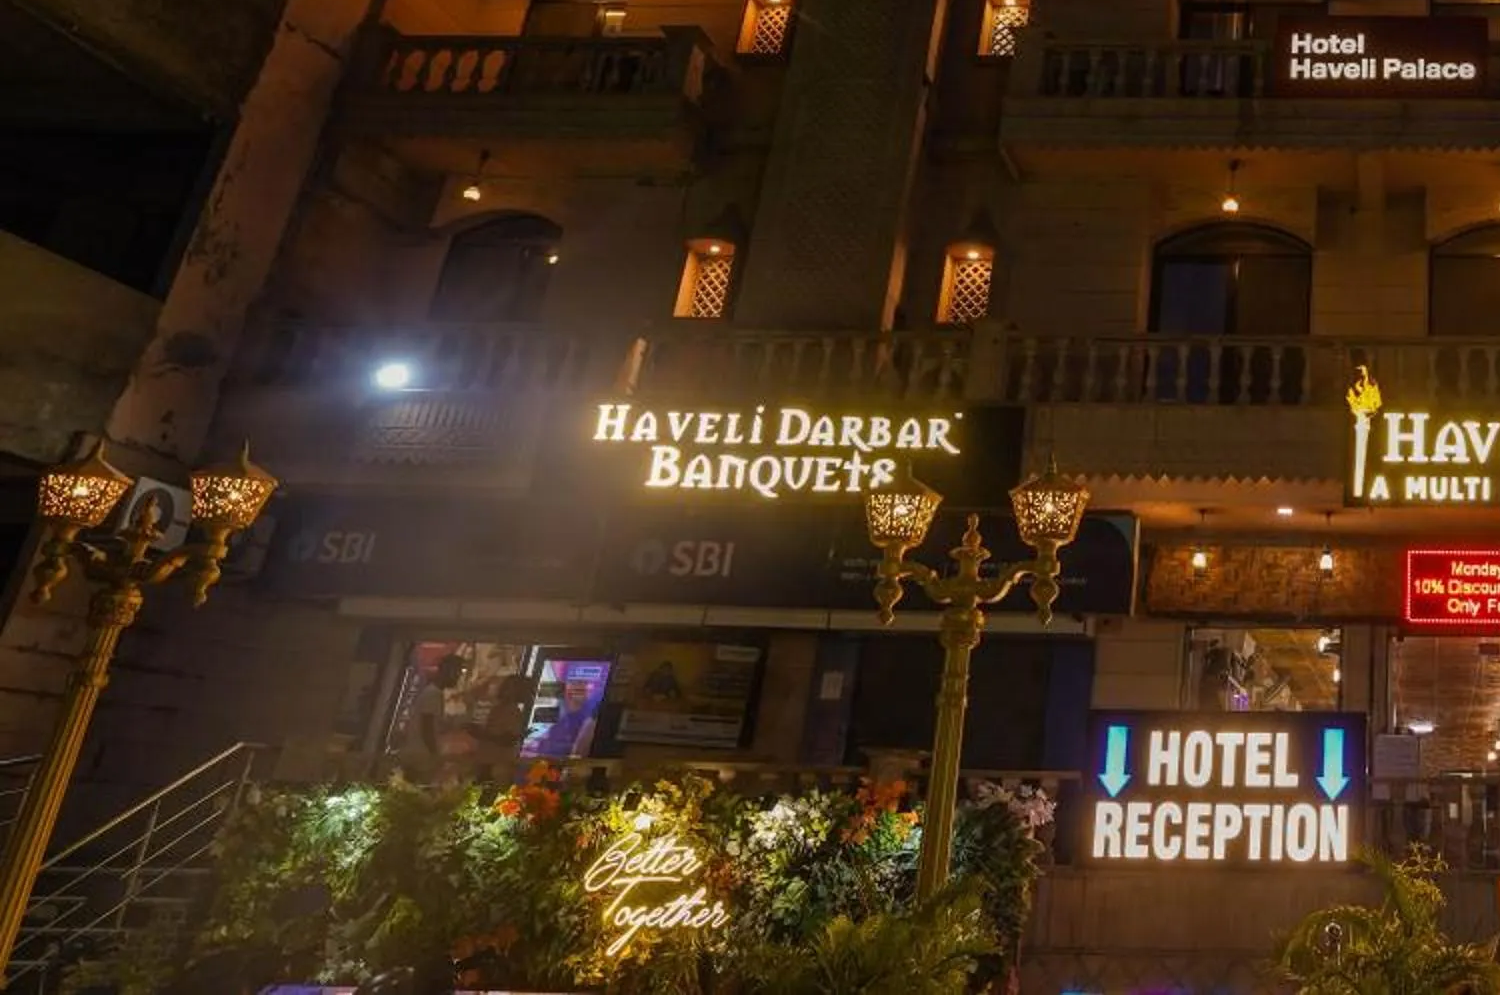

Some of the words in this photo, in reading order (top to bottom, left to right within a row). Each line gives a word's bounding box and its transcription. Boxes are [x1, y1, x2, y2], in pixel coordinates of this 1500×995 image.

[1290, 33, 1365, 55] Hotel
[1289, 58, 1377, 79] Haveli
[1382, 58, 1476, 79] Palace
[776, 409, 962, 454] DARBAR
[1369, 477, 1390, 501] A
[1404, 477, 1491, 501] MULTI
[316, 530, 378, 565] SBI
[667, 540, 736, 578] SBI
[1414, 580, 1445, 595] 10%
[1447, 599, 1481, 617] Only
[1147, 730, 1299, 788] HOTEL
[1092, 801, 1350, 862] RECEPTION
[584, 829, 702, 892] Better
[603, 875, 730, 957] Together
